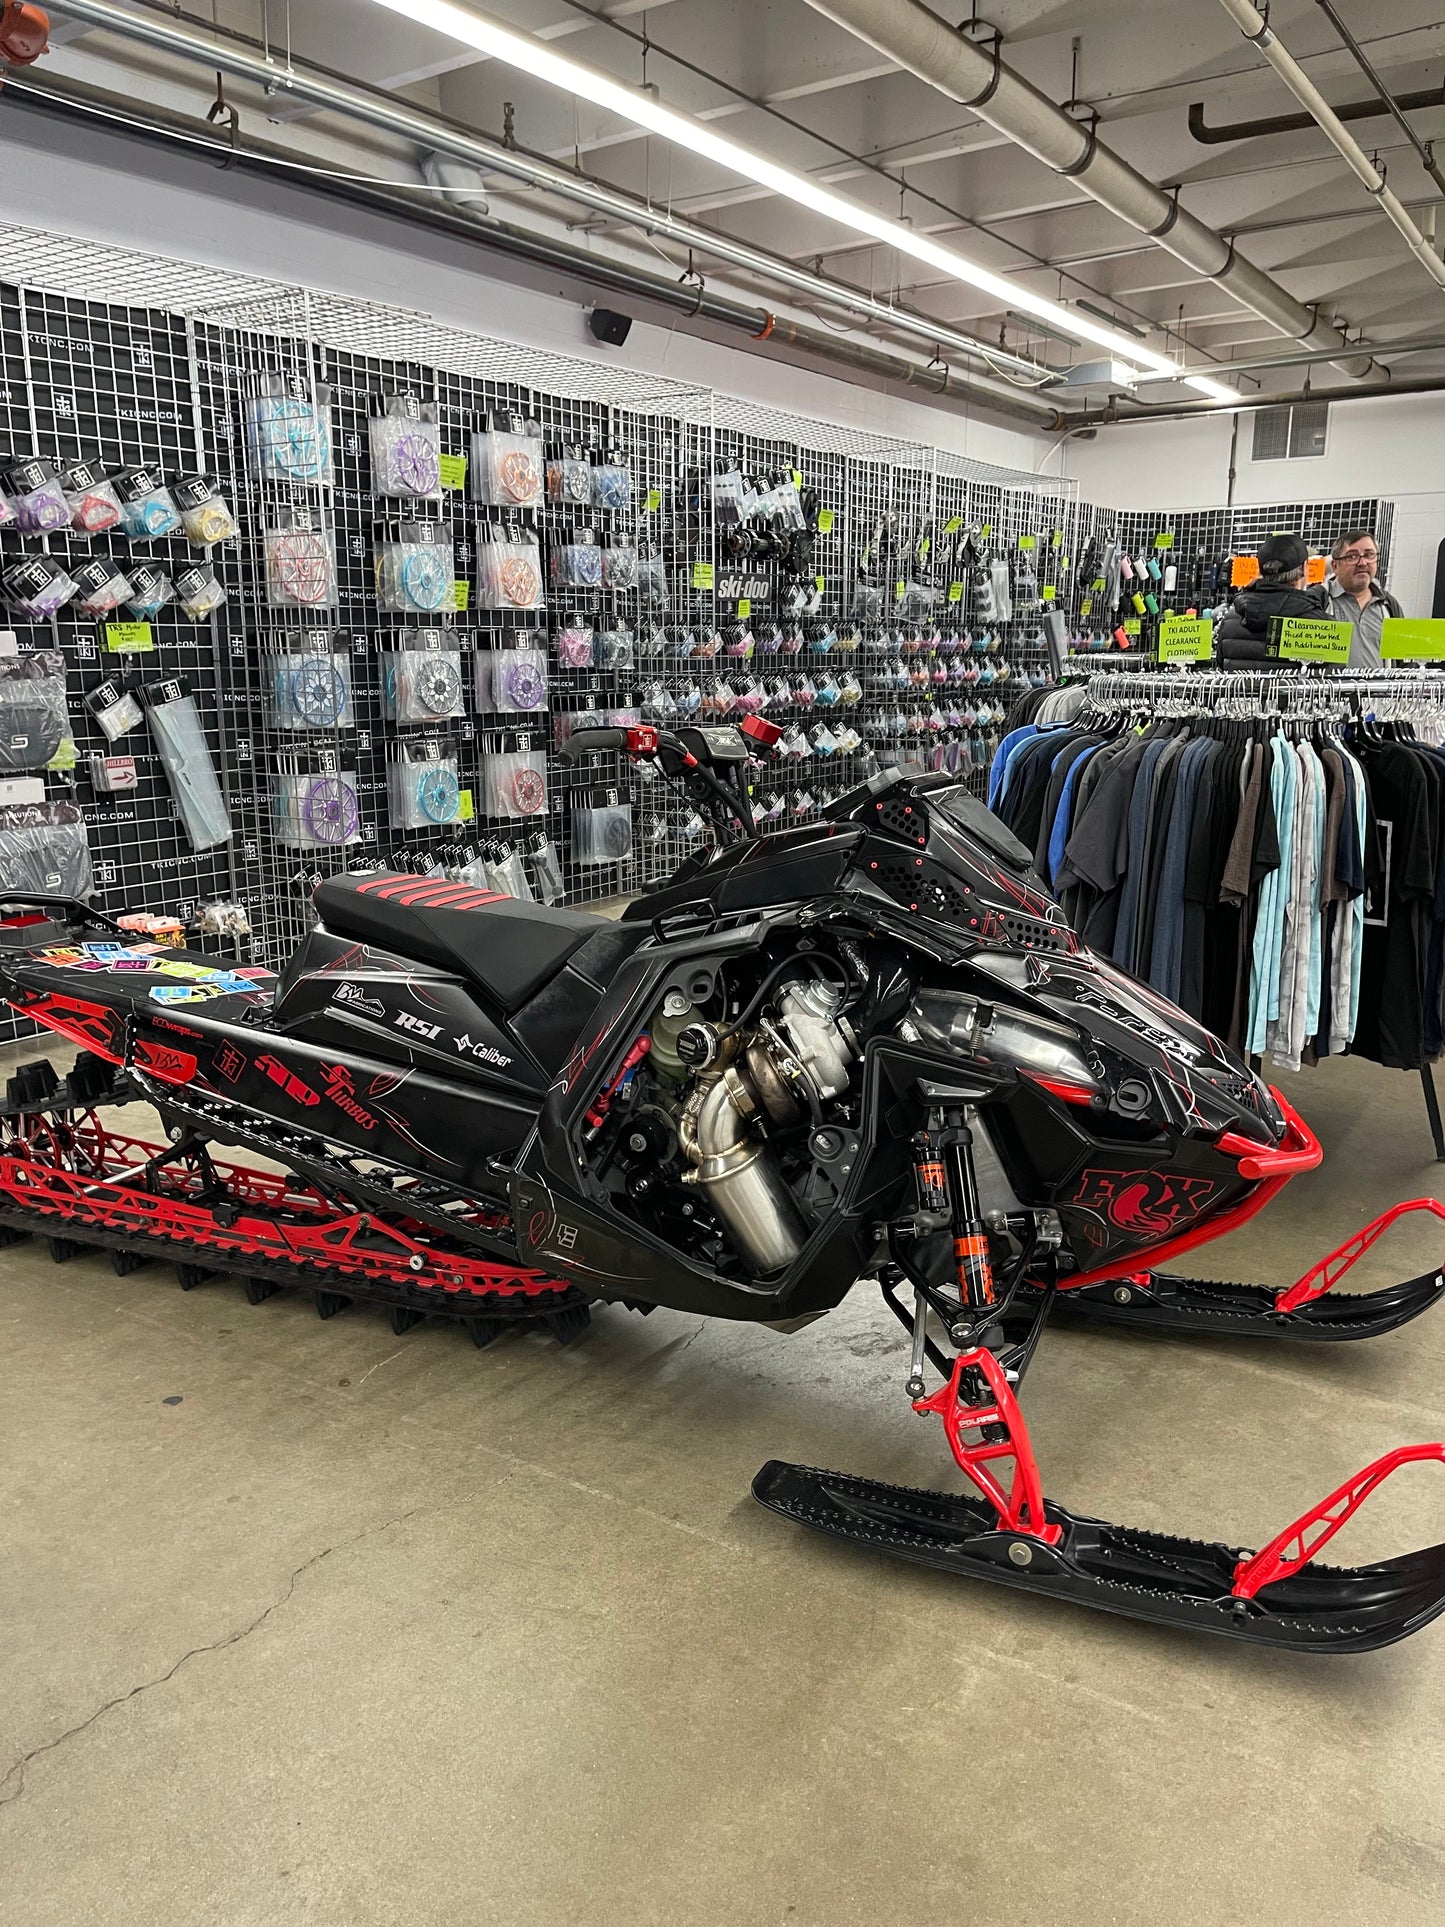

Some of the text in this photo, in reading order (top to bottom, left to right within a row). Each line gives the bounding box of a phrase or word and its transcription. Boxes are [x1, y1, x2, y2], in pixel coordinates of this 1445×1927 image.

[1168, 625, 1201, 635] TKI ADULT
[1165, 637, 1201, 646] CLEARANCE
[1283, 639, 1292, 649] No
[1294, 640, 1331, 650] Additional
[1167, 649, 1199, 657] CLOTHING
[393, 1009, 446, 1041] RSI
[472, 1042, 512, 1068] Caliber
[1073, 1169, 1215, 1238] FOX
